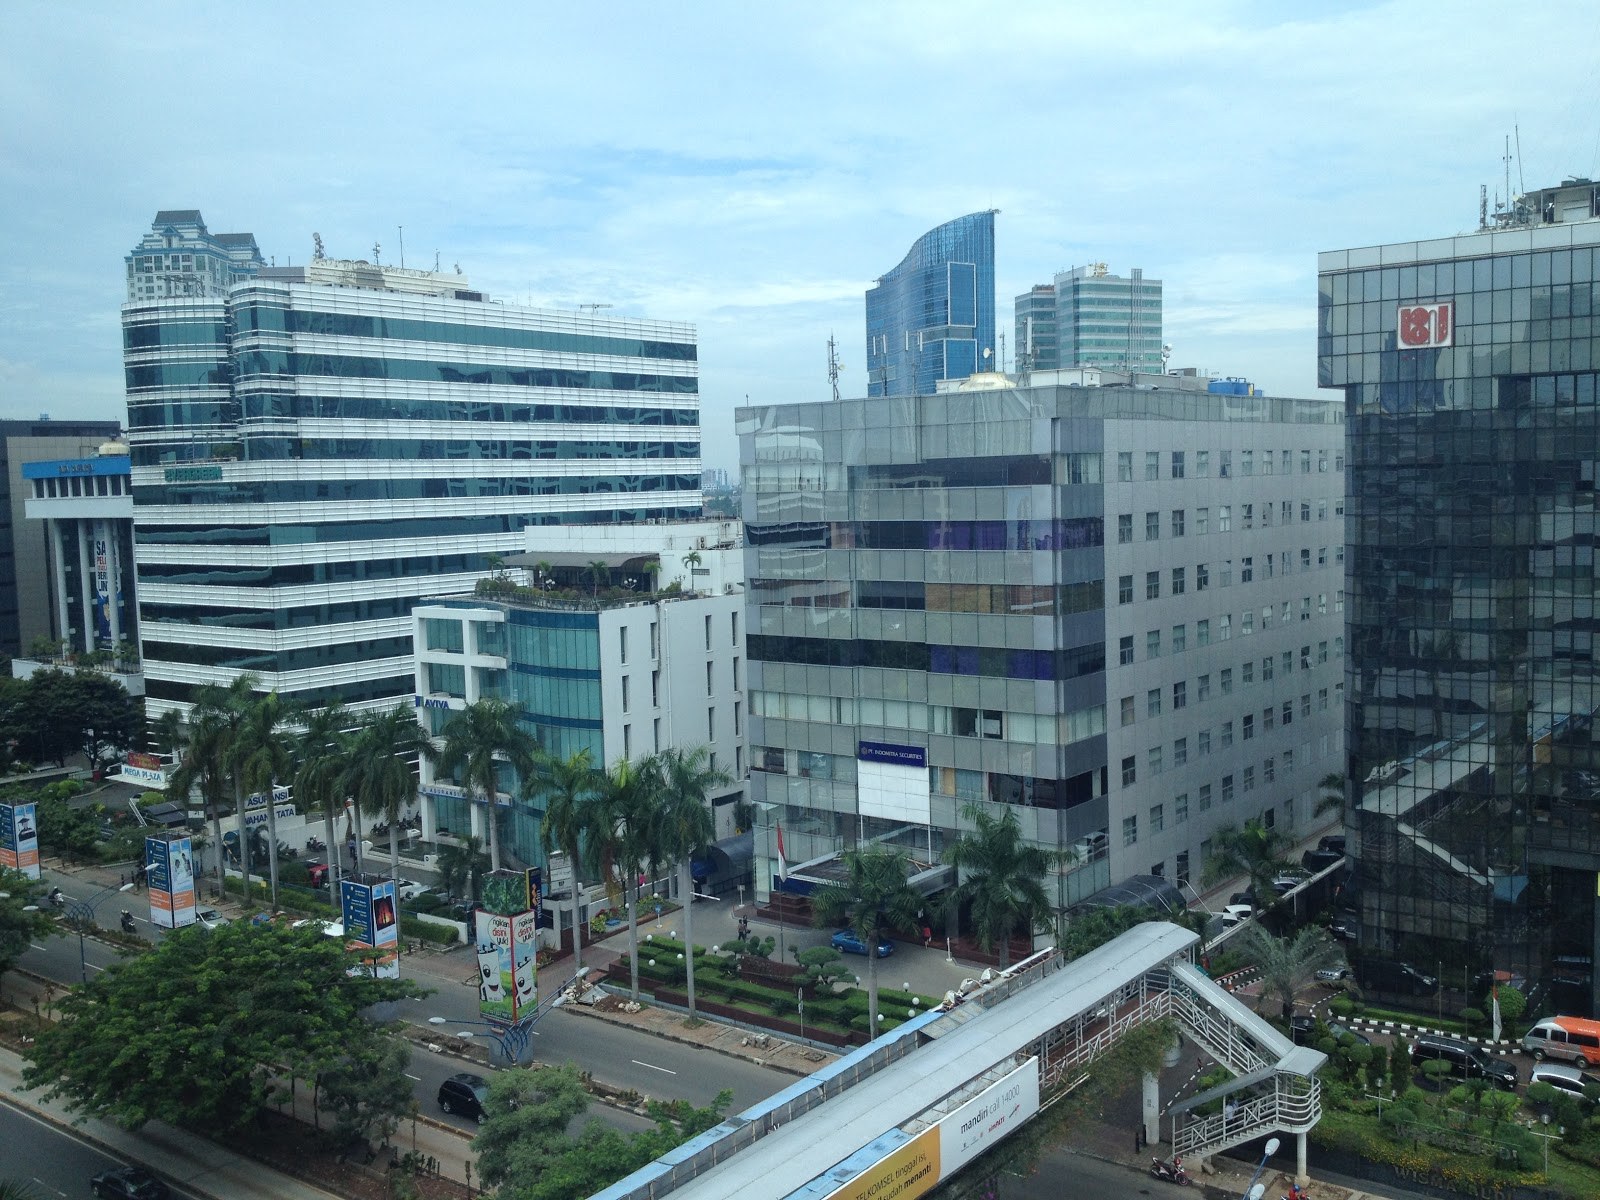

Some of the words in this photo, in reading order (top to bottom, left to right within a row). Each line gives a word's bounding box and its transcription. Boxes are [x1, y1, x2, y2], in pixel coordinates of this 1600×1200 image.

[425, 699, 449, 709] AVIVA
[899, 752, 922, 760] SECURITIES
[276, 808, 294, 819] TATA
[492, 928, 507, 937] disini
[517, 926, 532, 938] disini
[960, 1105, 988, 1134] mandiri
[989, 1096, 1000, 1114] call
[1001, 1083, 1020, 1106] 14000
[856, 1176, 895, 1200] TELKOMSEL
[895, 1156, 918, 1184] tinggal
[904, 1162, 932, 1189] menanti
